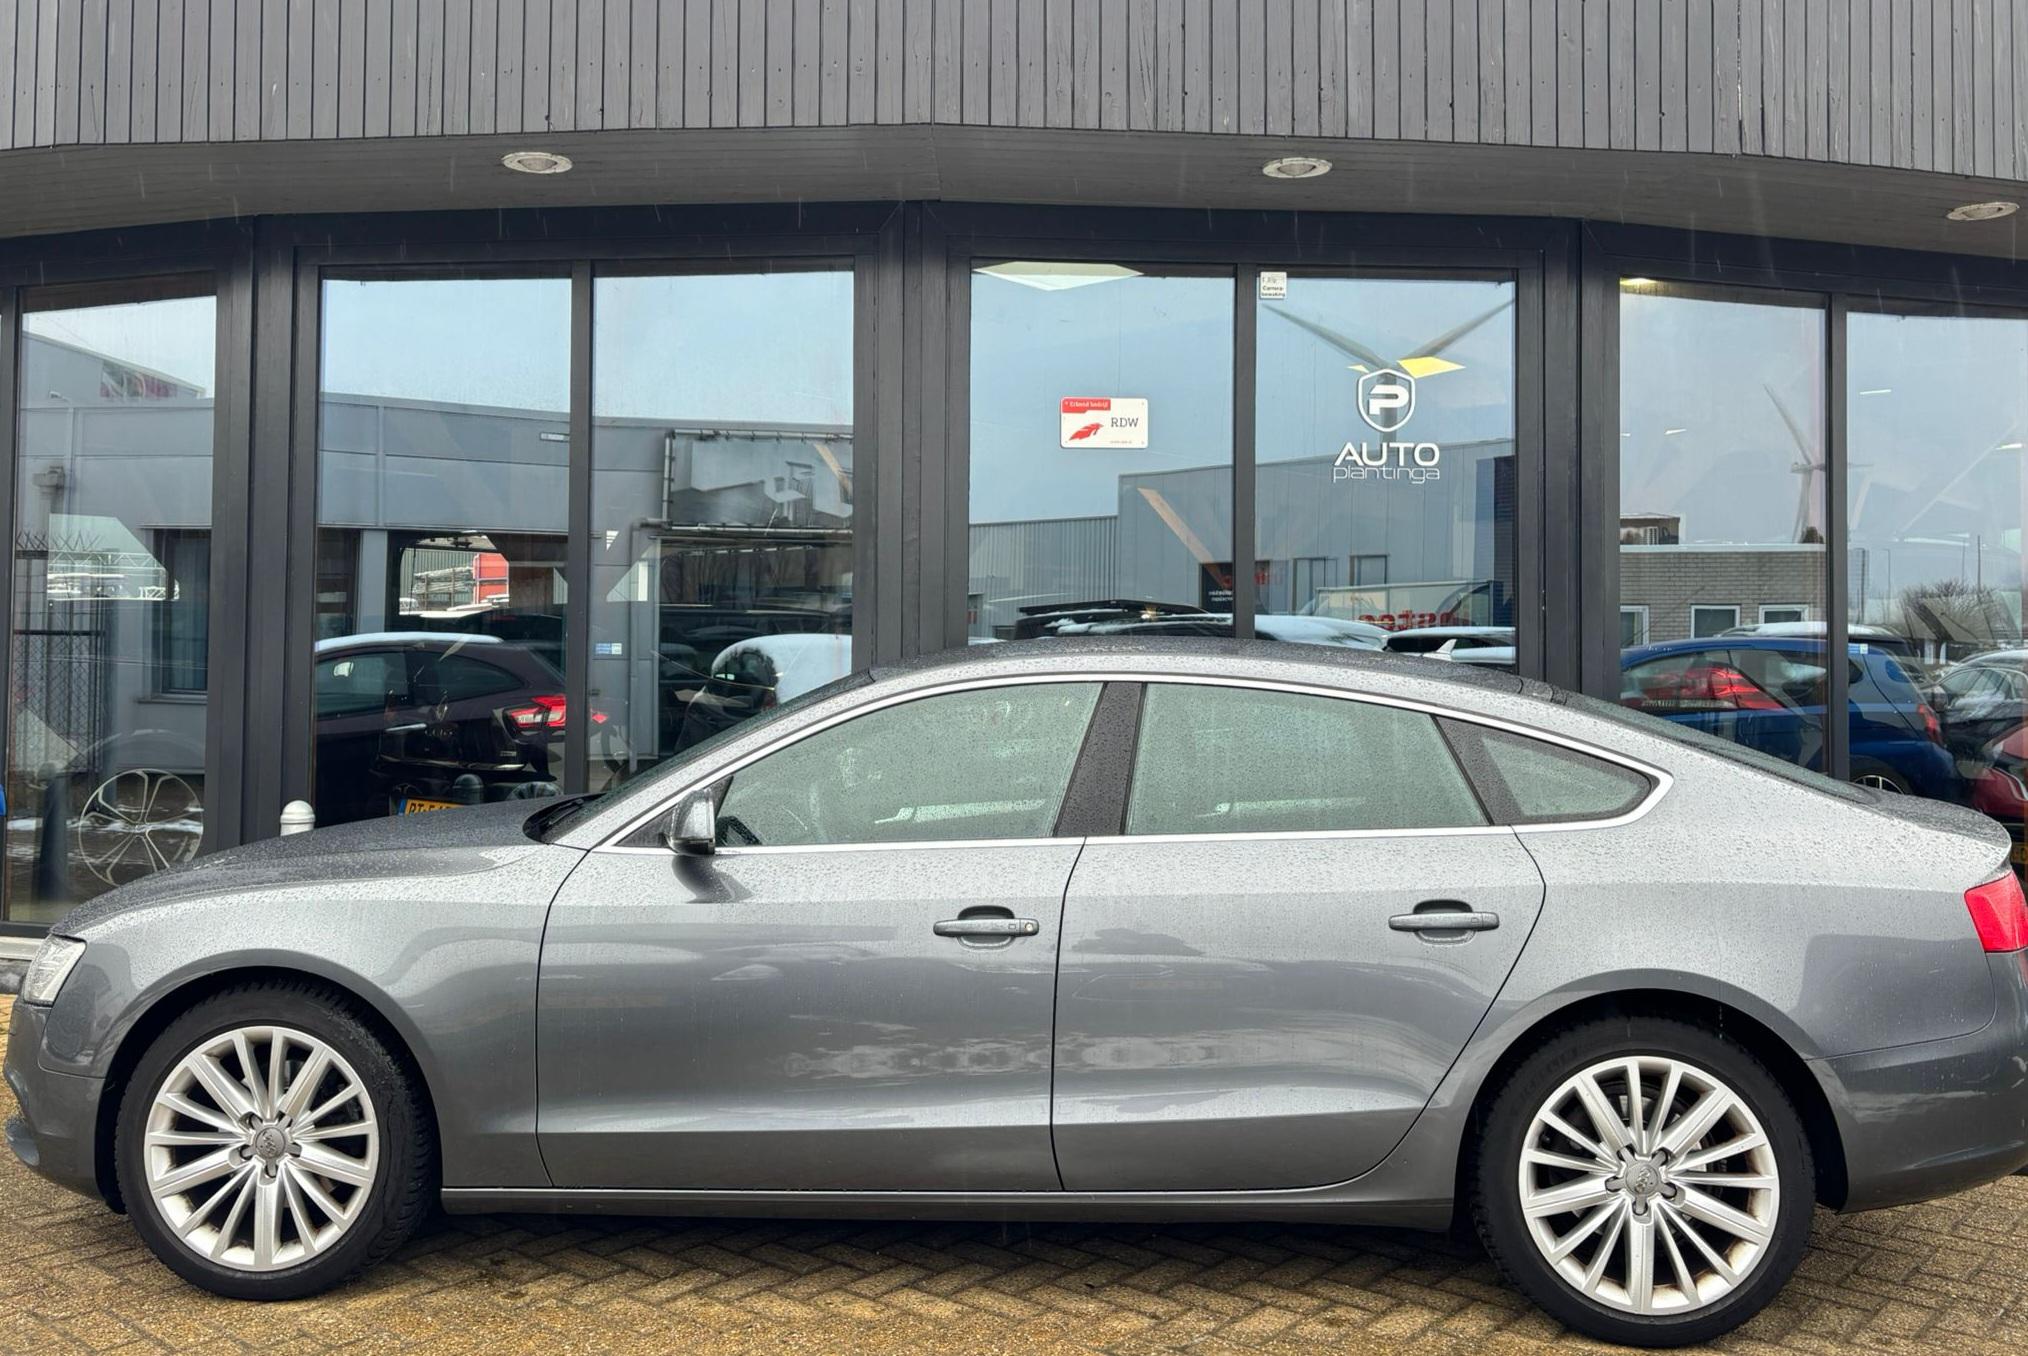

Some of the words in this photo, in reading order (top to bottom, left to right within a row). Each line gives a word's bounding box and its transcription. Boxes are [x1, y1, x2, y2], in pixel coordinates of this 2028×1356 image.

[1110, 417, 1139, 428] RDW
[1333, 442, 1440, 467] AUTO
[1332, 465, 1441, 485] plantinga
